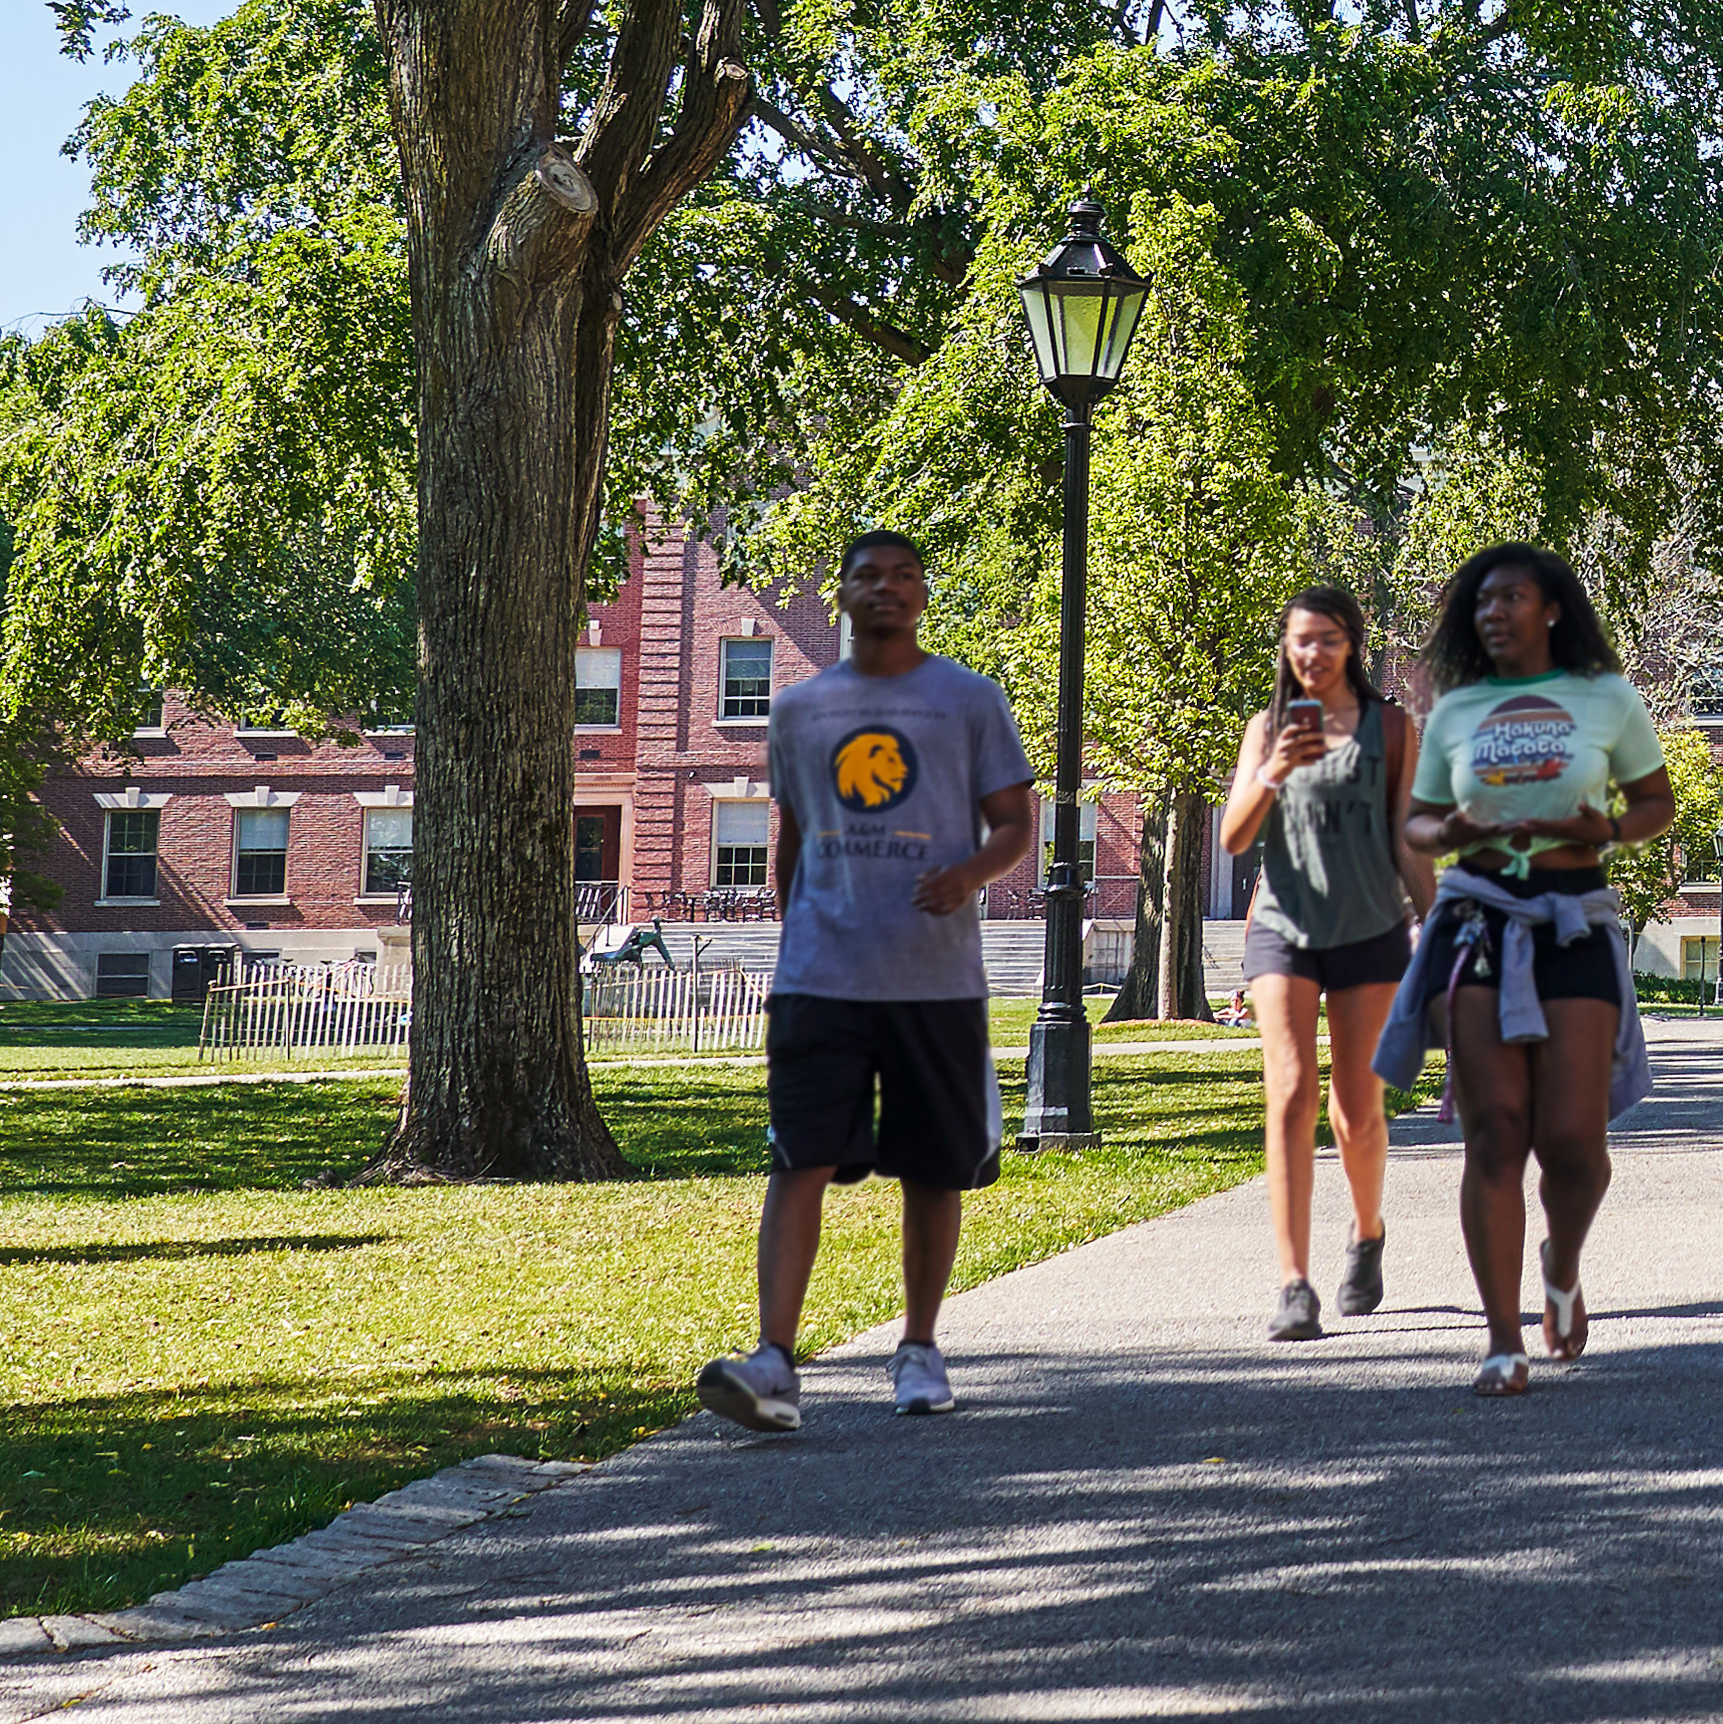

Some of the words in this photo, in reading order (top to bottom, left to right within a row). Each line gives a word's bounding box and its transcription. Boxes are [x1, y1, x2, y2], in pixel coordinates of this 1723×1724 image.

[1494, 722, 1570, 740] Hakuna
[1475, 740, 1565, 763] Matata
[845, 823, 886, 836] A&M
